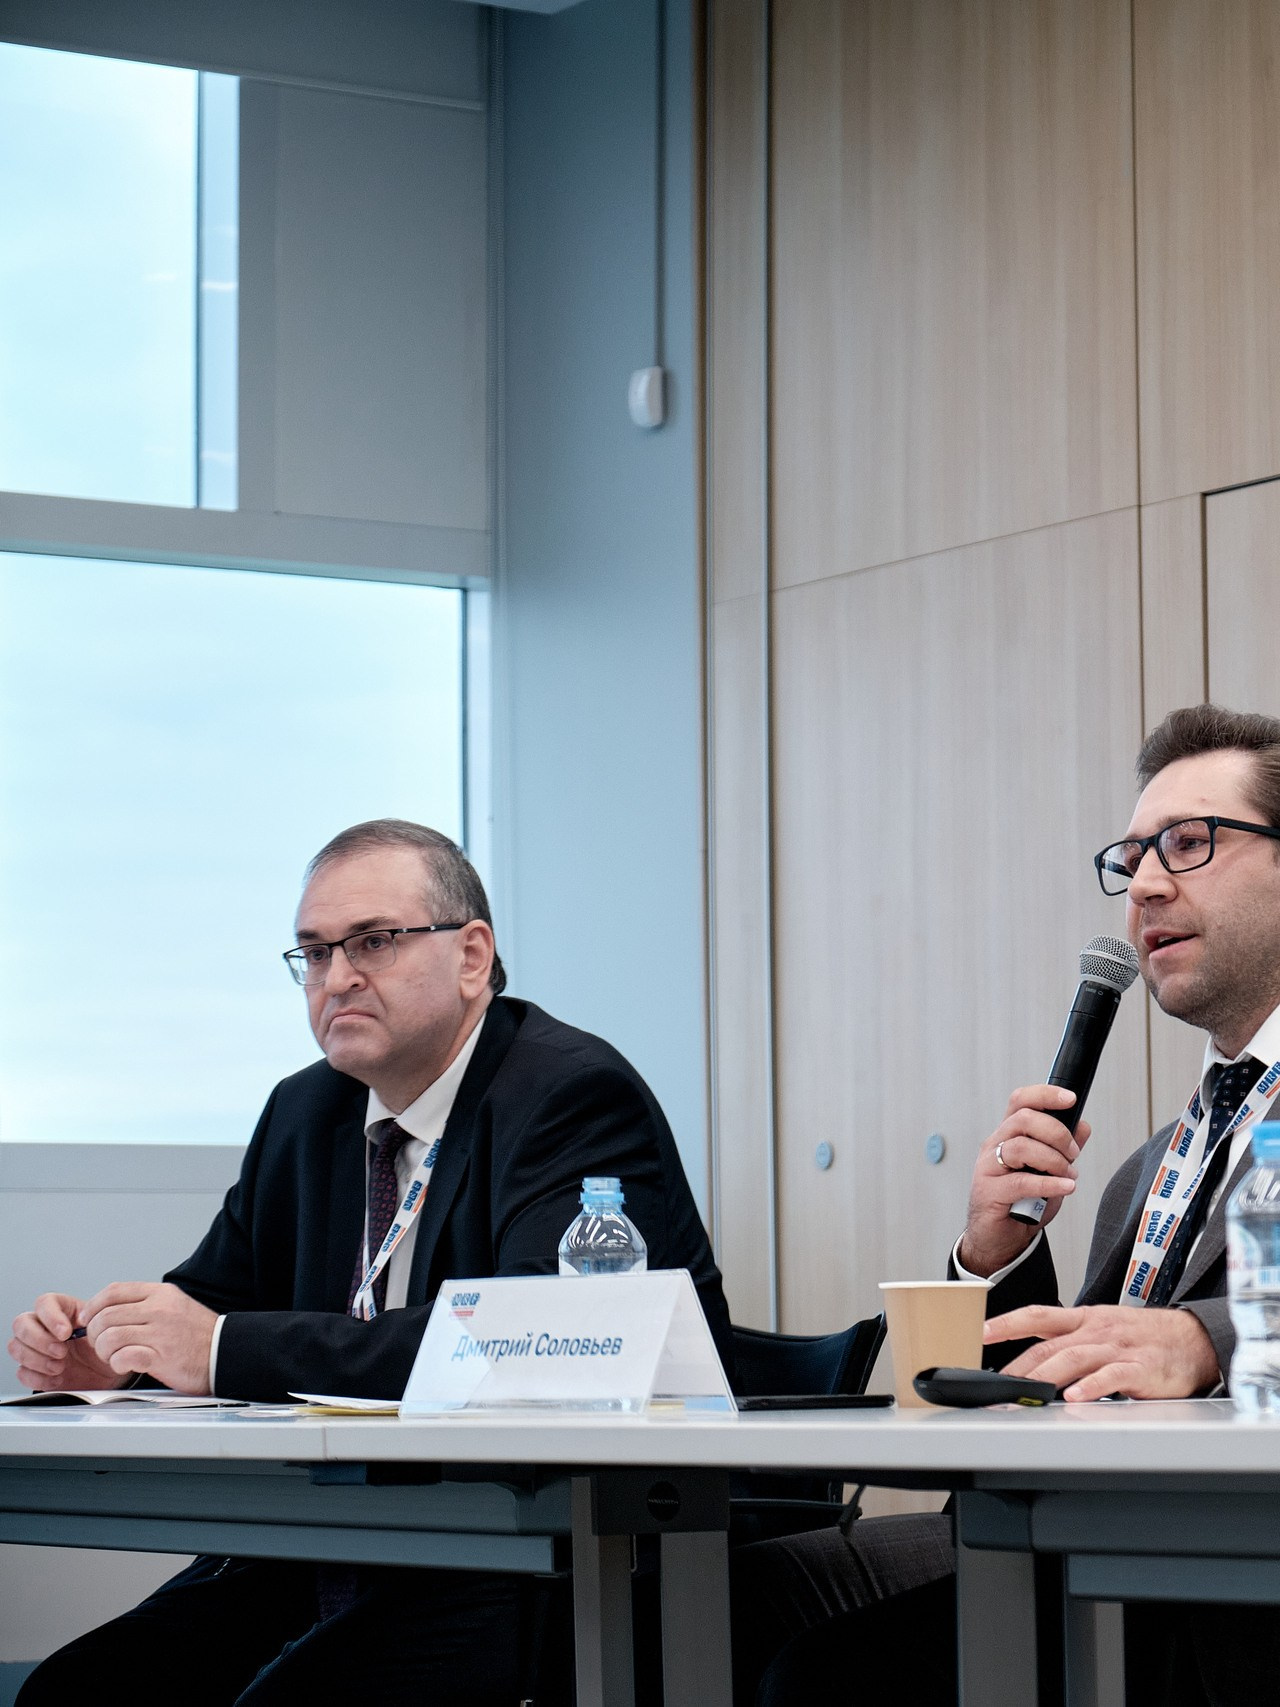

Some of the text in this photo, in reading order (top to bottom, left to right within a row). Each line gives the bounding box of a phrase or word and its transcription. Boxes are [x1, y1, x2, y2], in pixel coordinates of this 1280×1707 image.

[1128, 1261, 1151, 1297] MRF
[451, 1332, 623, 1362] Дмитрий Соловьев
